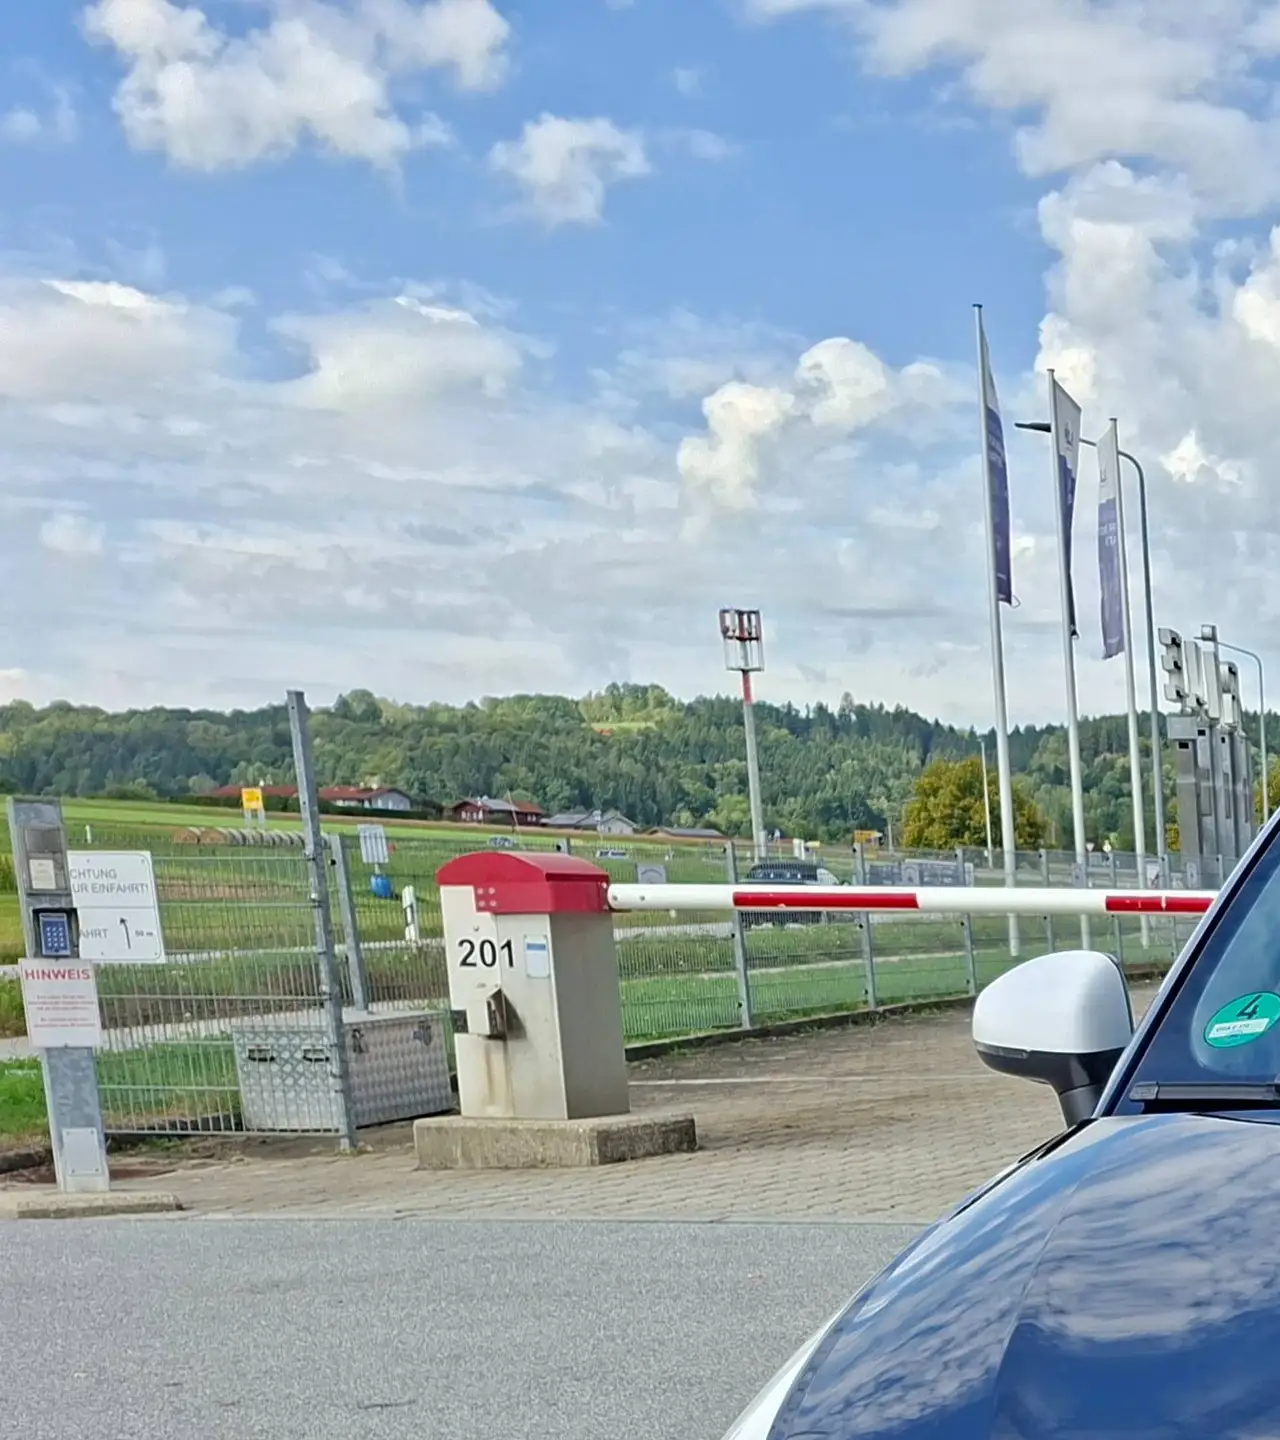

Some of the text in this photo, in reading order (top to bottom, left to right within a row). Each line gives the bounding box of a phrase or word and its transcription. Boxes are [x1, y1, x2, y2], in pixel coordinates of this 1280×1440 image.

[71, 868, 117, 880] CHTUNG
[458, 939, 514, 968] 201
[25, 968, 90, 981] HINWEIS
[1236, 994, 1262, 1020] 4
